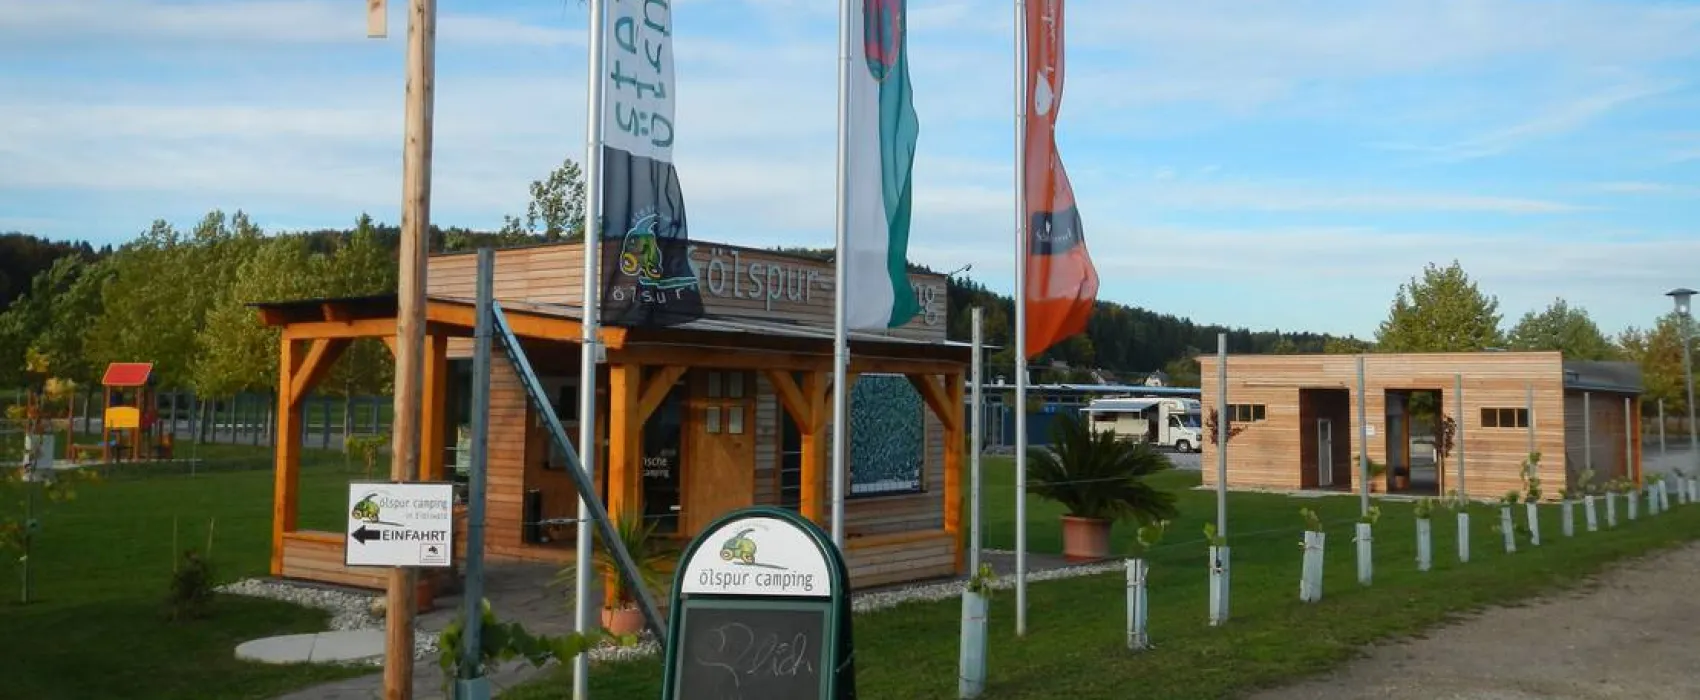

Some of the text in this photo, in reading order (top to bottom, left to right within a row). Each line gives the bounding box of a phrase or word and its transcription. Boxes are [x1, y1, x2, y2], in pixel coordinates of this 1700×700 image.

[707, 248, 820, 312] ölspur
[412, 498, 448, 511] camping
[382, 530, 447, 541] EINFAHRT
[699, 568, 813, 591] ölspur camping
